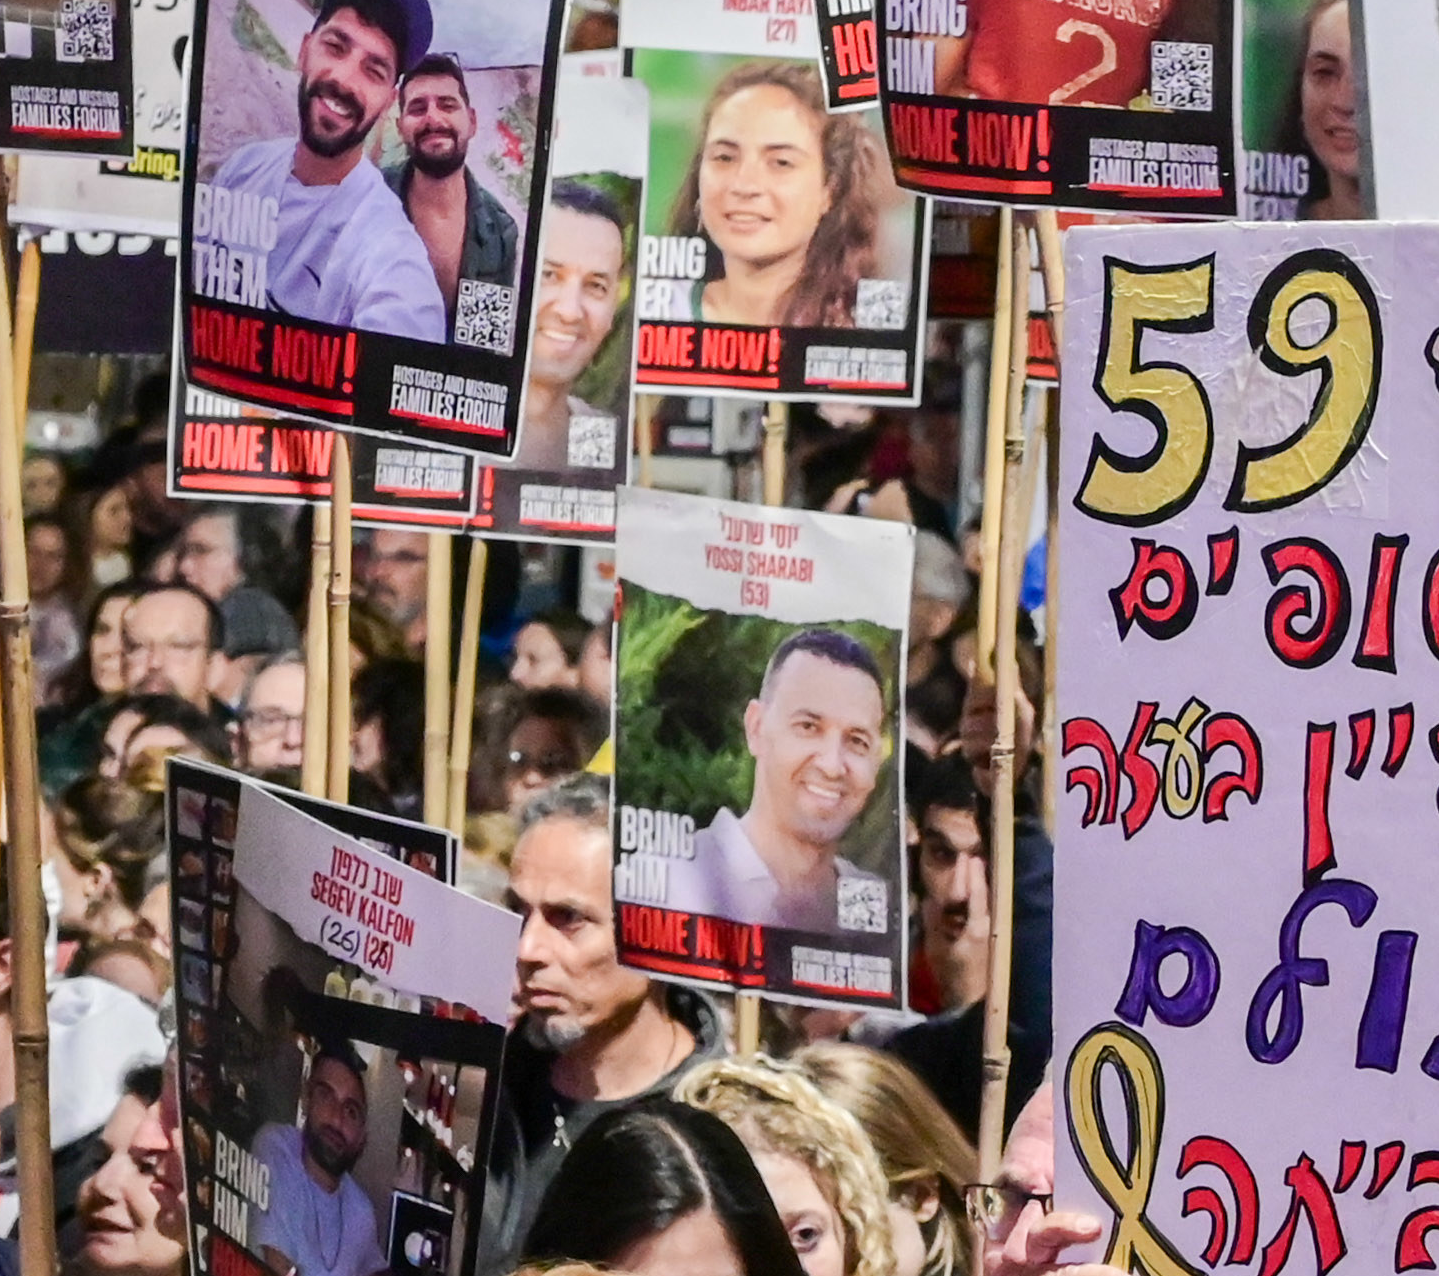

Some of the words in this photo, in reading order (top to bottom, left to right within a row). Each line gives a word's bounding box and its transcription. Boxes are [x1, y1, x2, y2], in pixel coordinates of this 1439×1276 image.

[765, 18, 797, 43] (27)
[1049, 18, 1115, 105] 2
[887, 36, 934, 93] HIM
[891, 103, 962, 163] HOME
[968, 110, 1051, 173] NOW!
[1088, 156, 1159, 186] FAMILIES
[1163, 162, 1218, 190] FORUM
[194, 185, 279, 251] BRING
[191, 241, 268, 309] THEM
[191, 304, 266, 368] HOME
[271, 325, 357, 391] NOW!
[1077, 247, 1387, 523] 59
[704, 545, 743, 573] YOSSI
[746, 551, 813, 582] SHARABI
[740, 580, 769, 608] (53)
[1061, 697, 1263, 843] בעזה
[621, 805, 696, 858] BRING
[310, 871, 356, 915] SEGEV
[359, 895, 415, 948] KALFON
[616, 854, 669, 903] HIM
[214, 1131, 271, 1212] BRING
[213, 1181, 249, 1248] HIM
